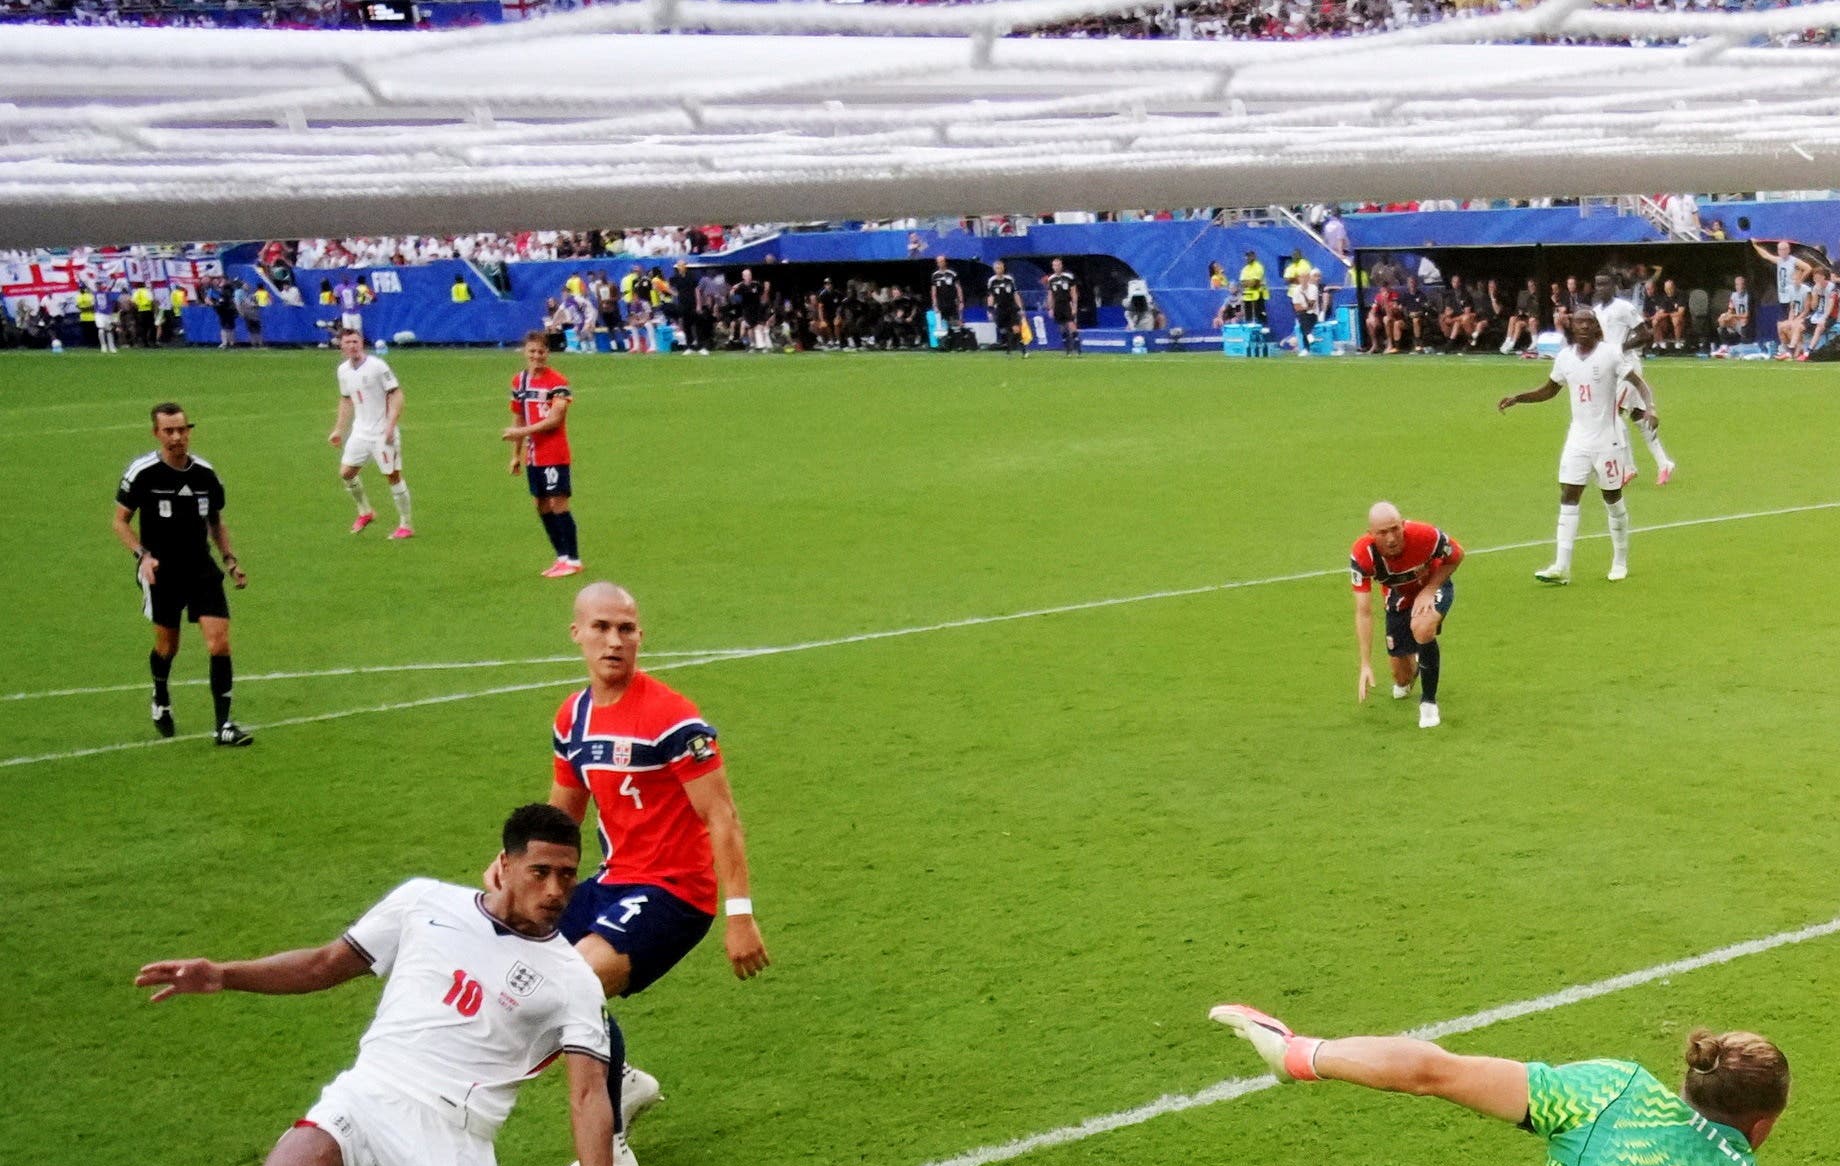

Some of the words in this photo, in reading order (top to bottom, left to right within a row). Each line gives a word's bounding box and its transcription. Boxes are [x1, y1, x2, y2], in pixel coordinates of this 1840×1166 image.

[1578, 384, 1592, 402] 21
[1604, 459, 1619, 478] 21
[619, 774, 644, 809] 4
[619, 895, 649, 924] 4
[442, 969, 484, 1017] 10
